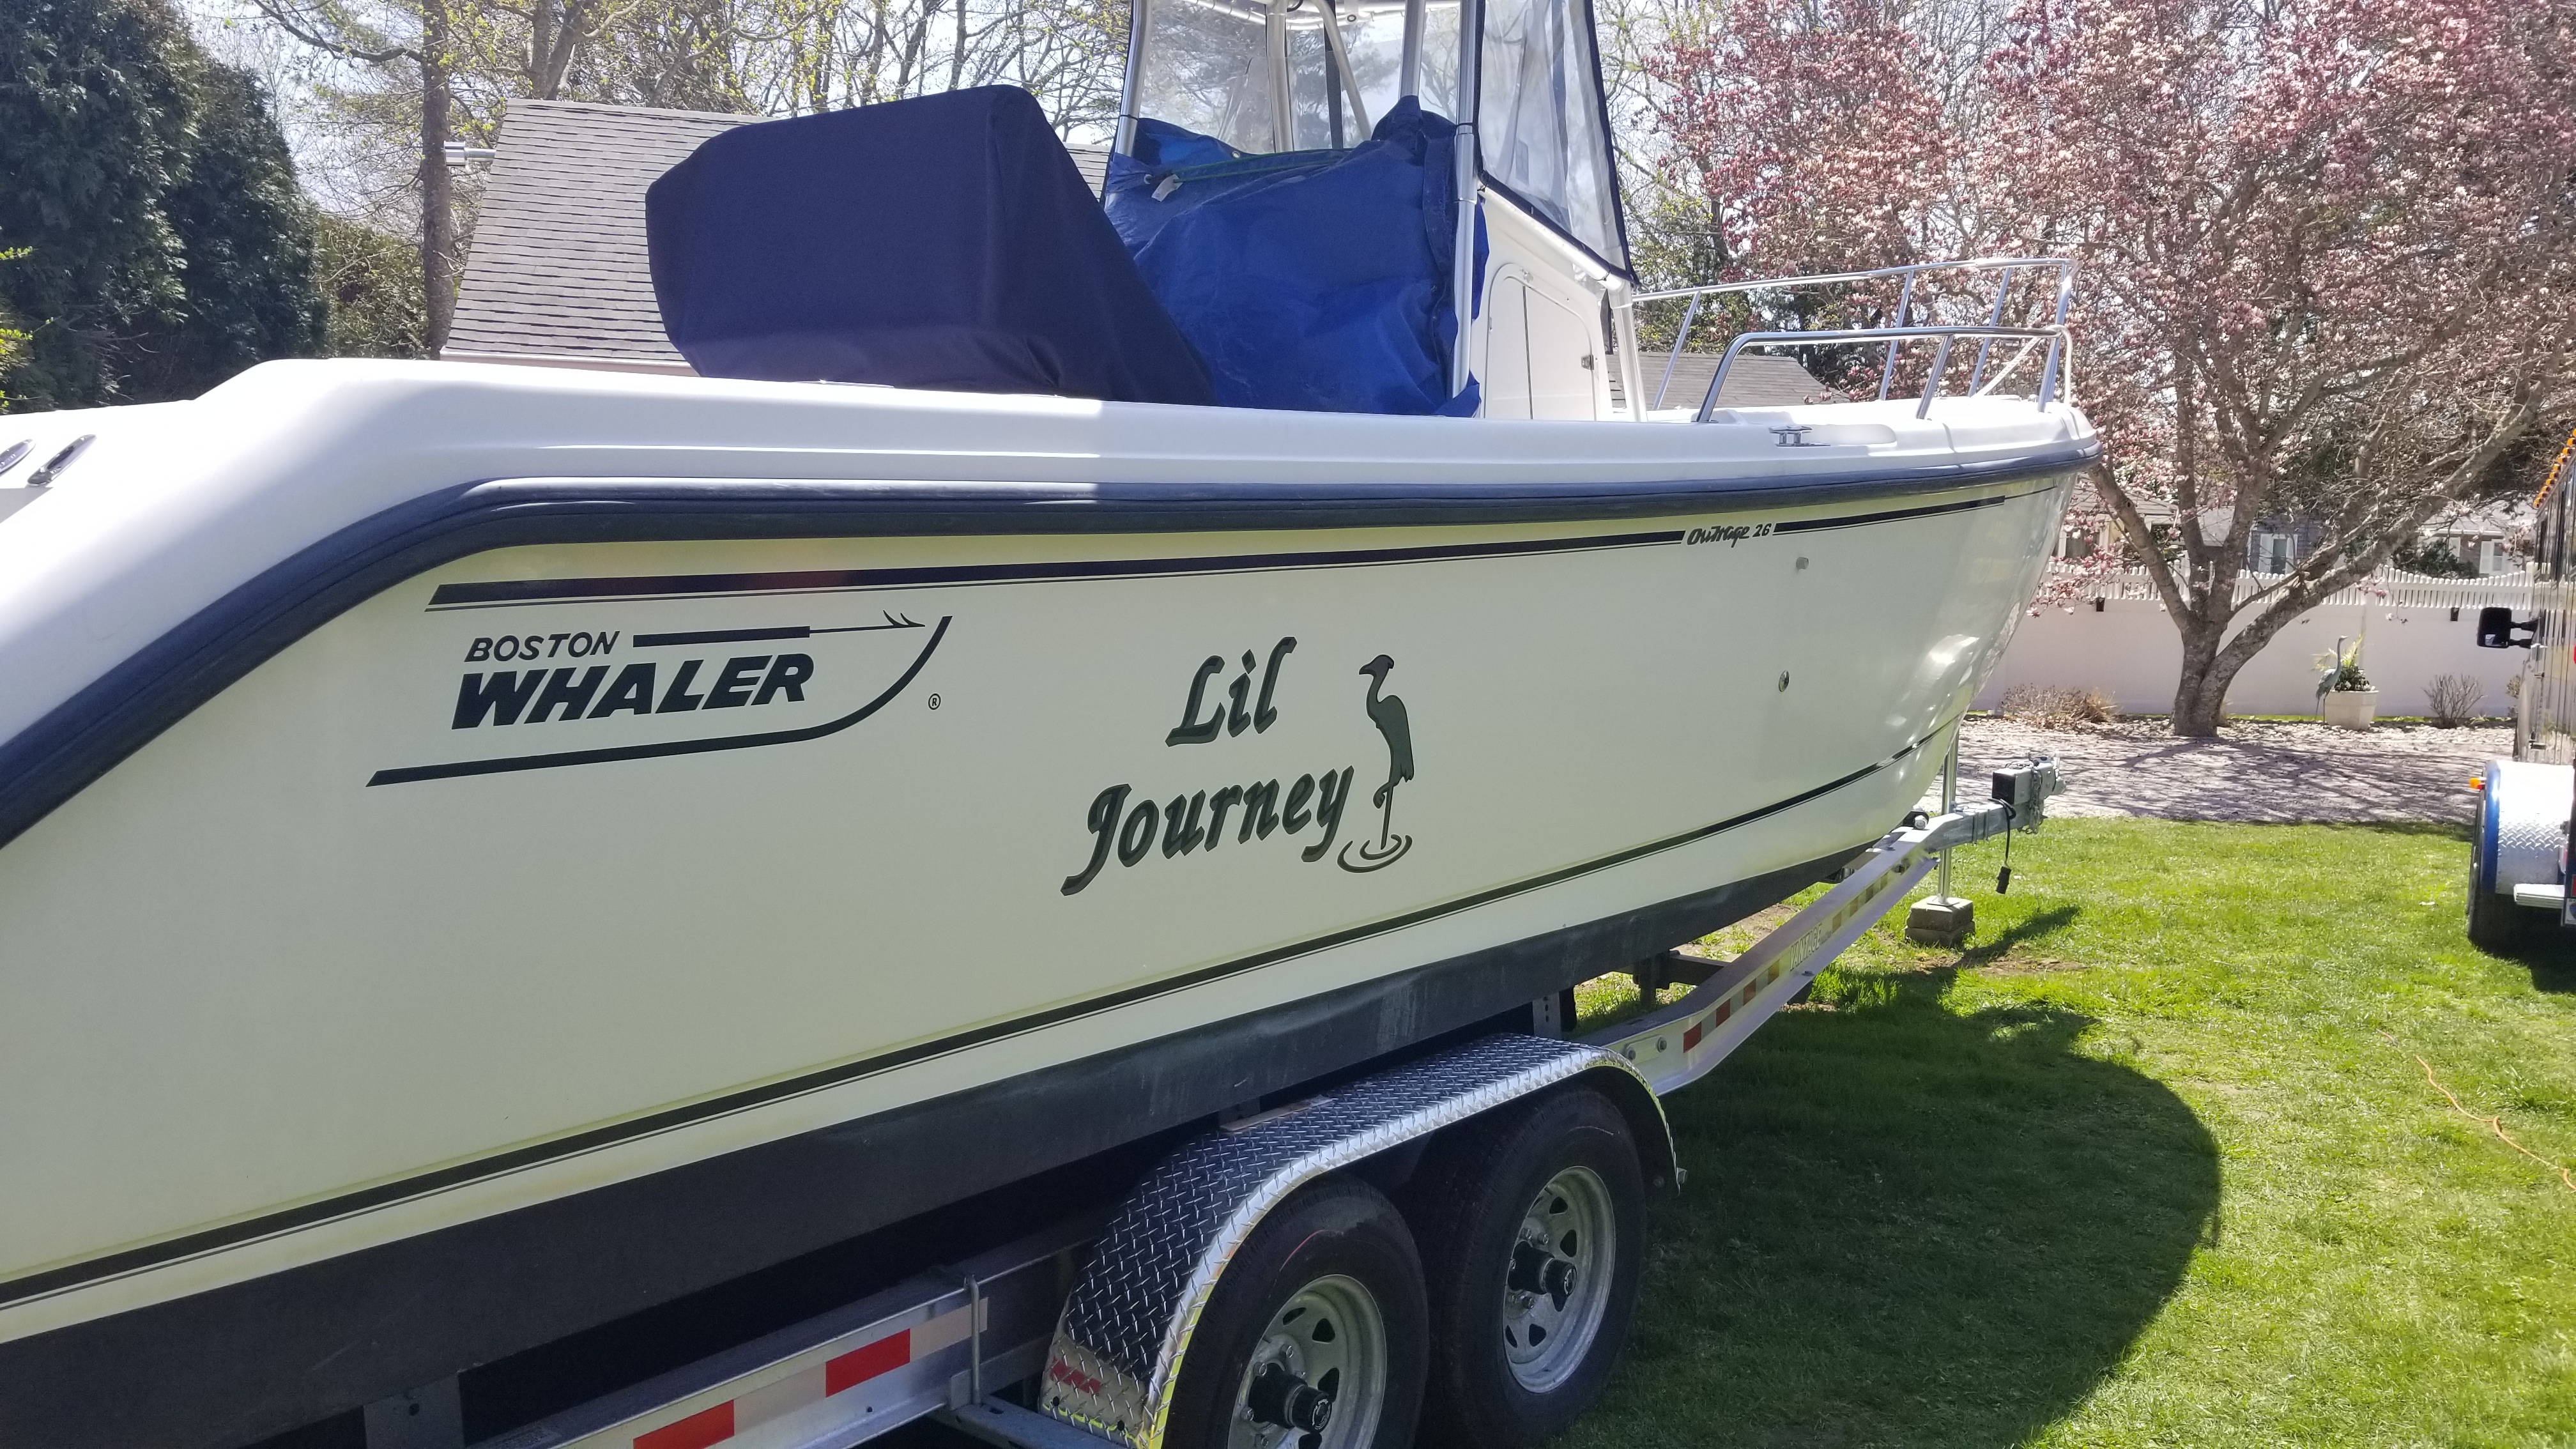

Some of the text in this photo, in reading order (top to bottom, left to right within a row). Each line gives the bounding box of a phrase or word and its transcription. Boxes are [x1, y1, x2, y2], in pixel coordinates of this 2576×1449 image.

[1687, 523, 1772, 548] Outrage 26
[464, 631, 620, 663] BOSTON
[451, 653, 815, 730] WHALER
[1165, 636, 1298, 747] Lil
[1060, 765, 1354, 896] Journey
[1790, 922, 1823, 972] VANTAGE
